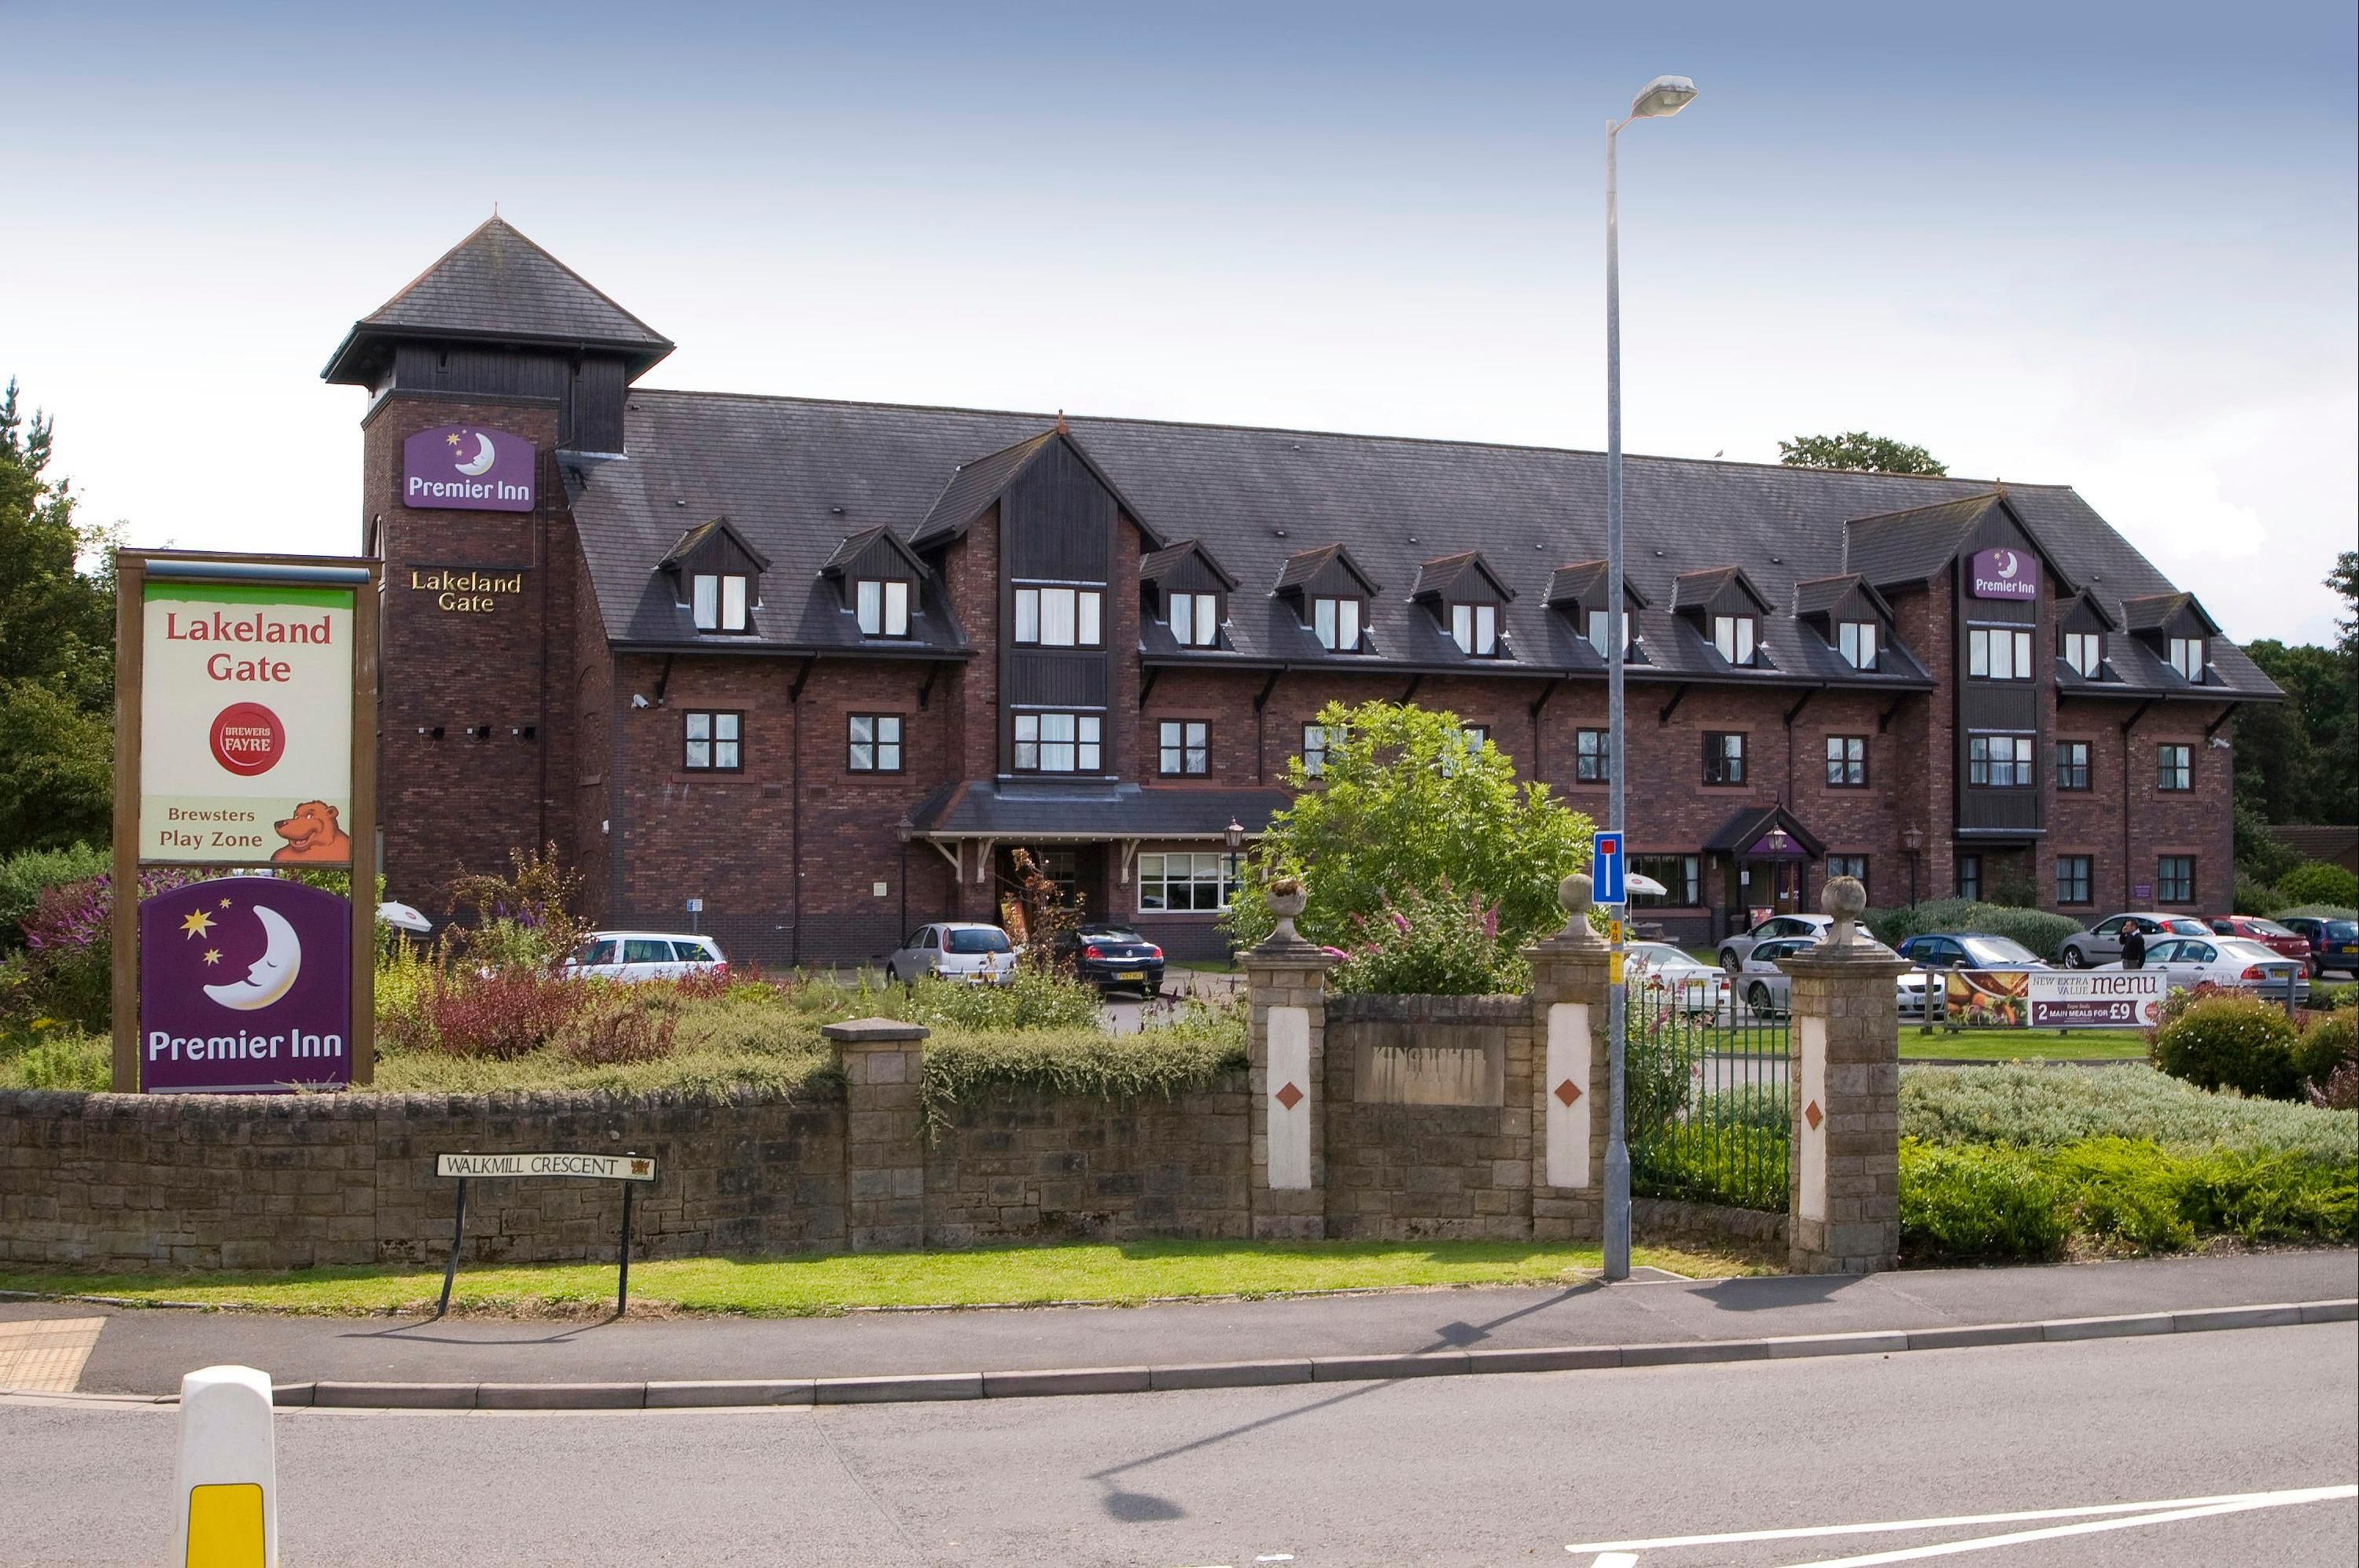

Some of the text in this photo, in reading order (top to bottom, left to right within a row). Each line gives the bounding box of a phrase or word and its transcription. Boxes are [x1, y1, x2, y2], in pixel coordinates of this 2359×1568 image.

[409, 477, 529, 500] Premier Inn
[411, 570, 521, 594] Lakeland
[1976, 578, 2034, 594] Premier Inn
[438, 592, 495, 613] Gate
[166, 611, 332, 645] Lakeland
[207, 653, 291, 683] Gate
[225, 727, 271, 736] BREWERS
[225, 738, 270, 751] FAYRE
[168, 808, 255, 822] Brewsters
[160, 830, 263, 850] Play Zone
[2033, 977, 2089, 986] NEW EXTRA
[2057, 986, 2089, 995] VALUE
[2091, 976, 2158, 995] menu
[2038, 1004, 2048, 1020] 2
[2049, 1009, 2068, 1018] MAIN
[2068, 1009, 2092, 1018] MEALS
[2110, 1003, 2130, 1019] £9
[149, 1029, 342, 1061] Premier Inn
[447, 1157, 619, 1175] WALKMILL CRESCENT
